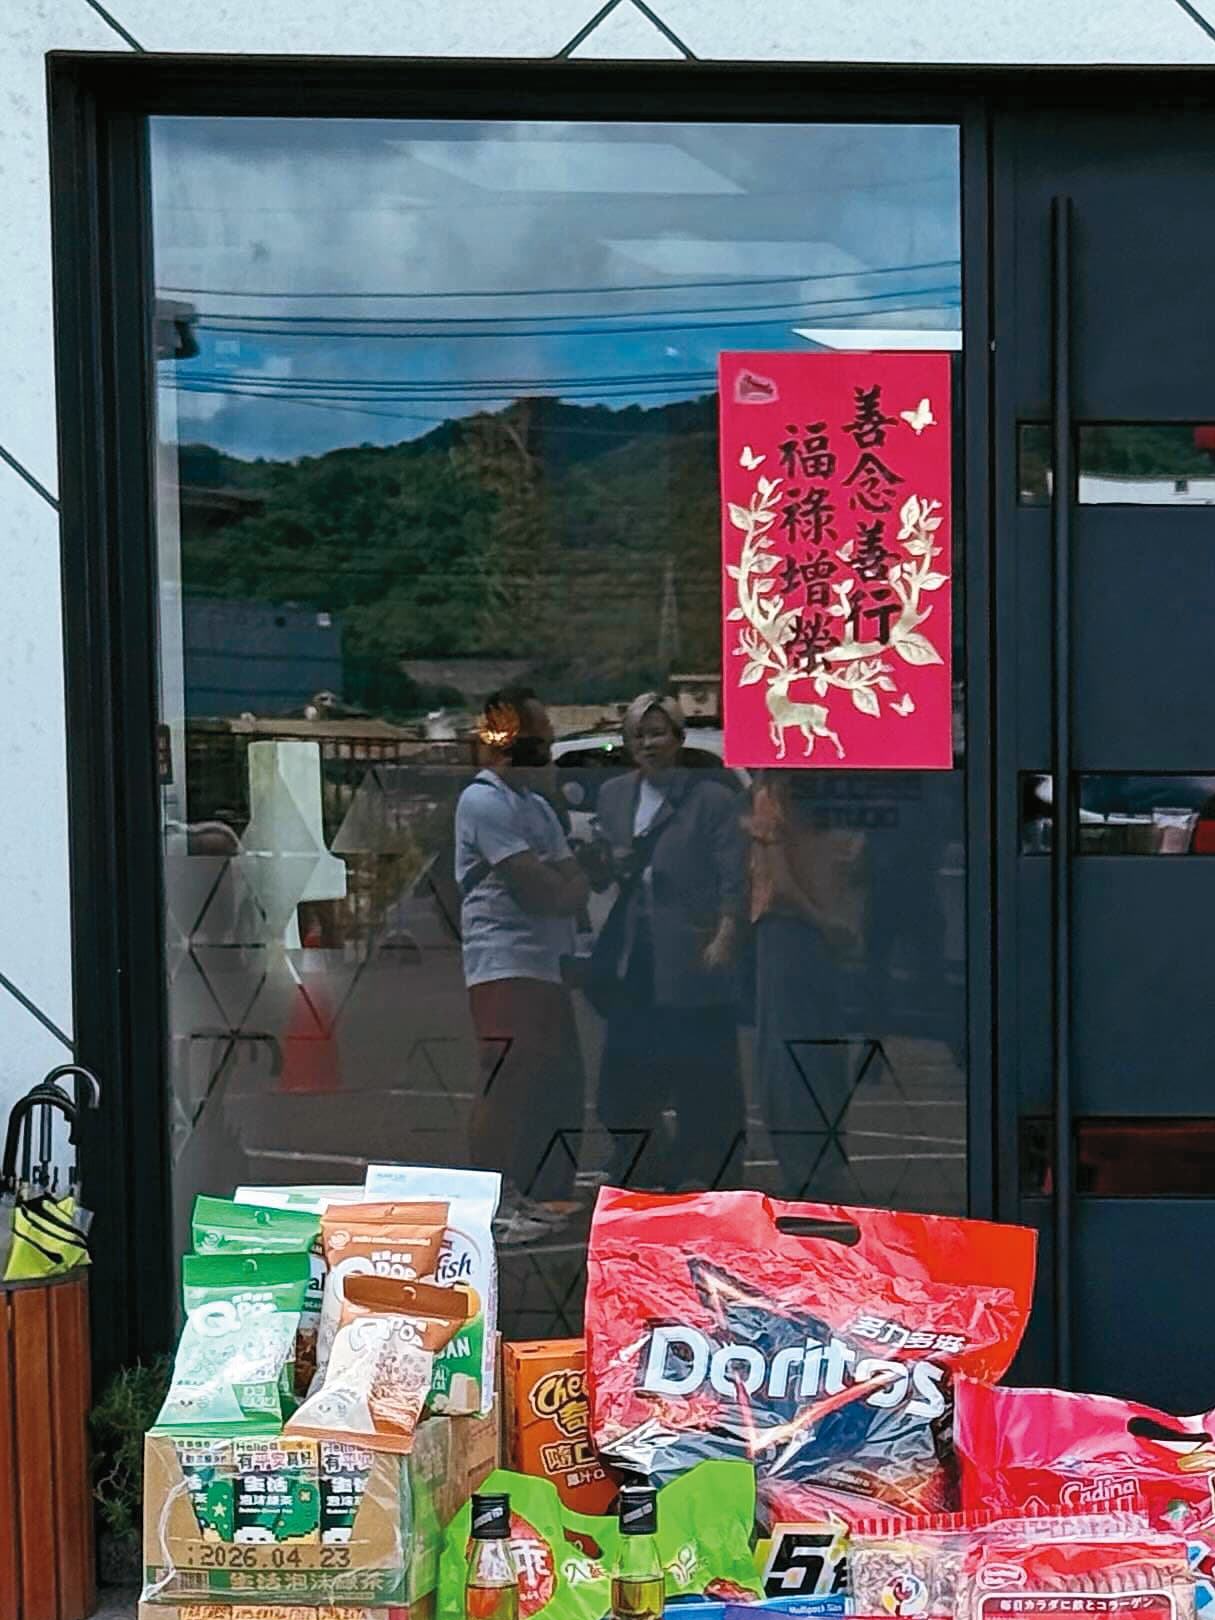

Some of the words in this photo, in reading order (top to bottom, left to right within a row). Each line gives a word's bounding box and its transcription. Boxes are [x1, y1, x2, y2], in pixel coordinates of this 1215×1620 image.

[842, 384, 904, 647] 善念善行
[851, 1315, 966, 1353] 多力多滋
[637, 1325, 948, 1418] Doritos
[1062, 1477, 1137, 1505] Cadina
